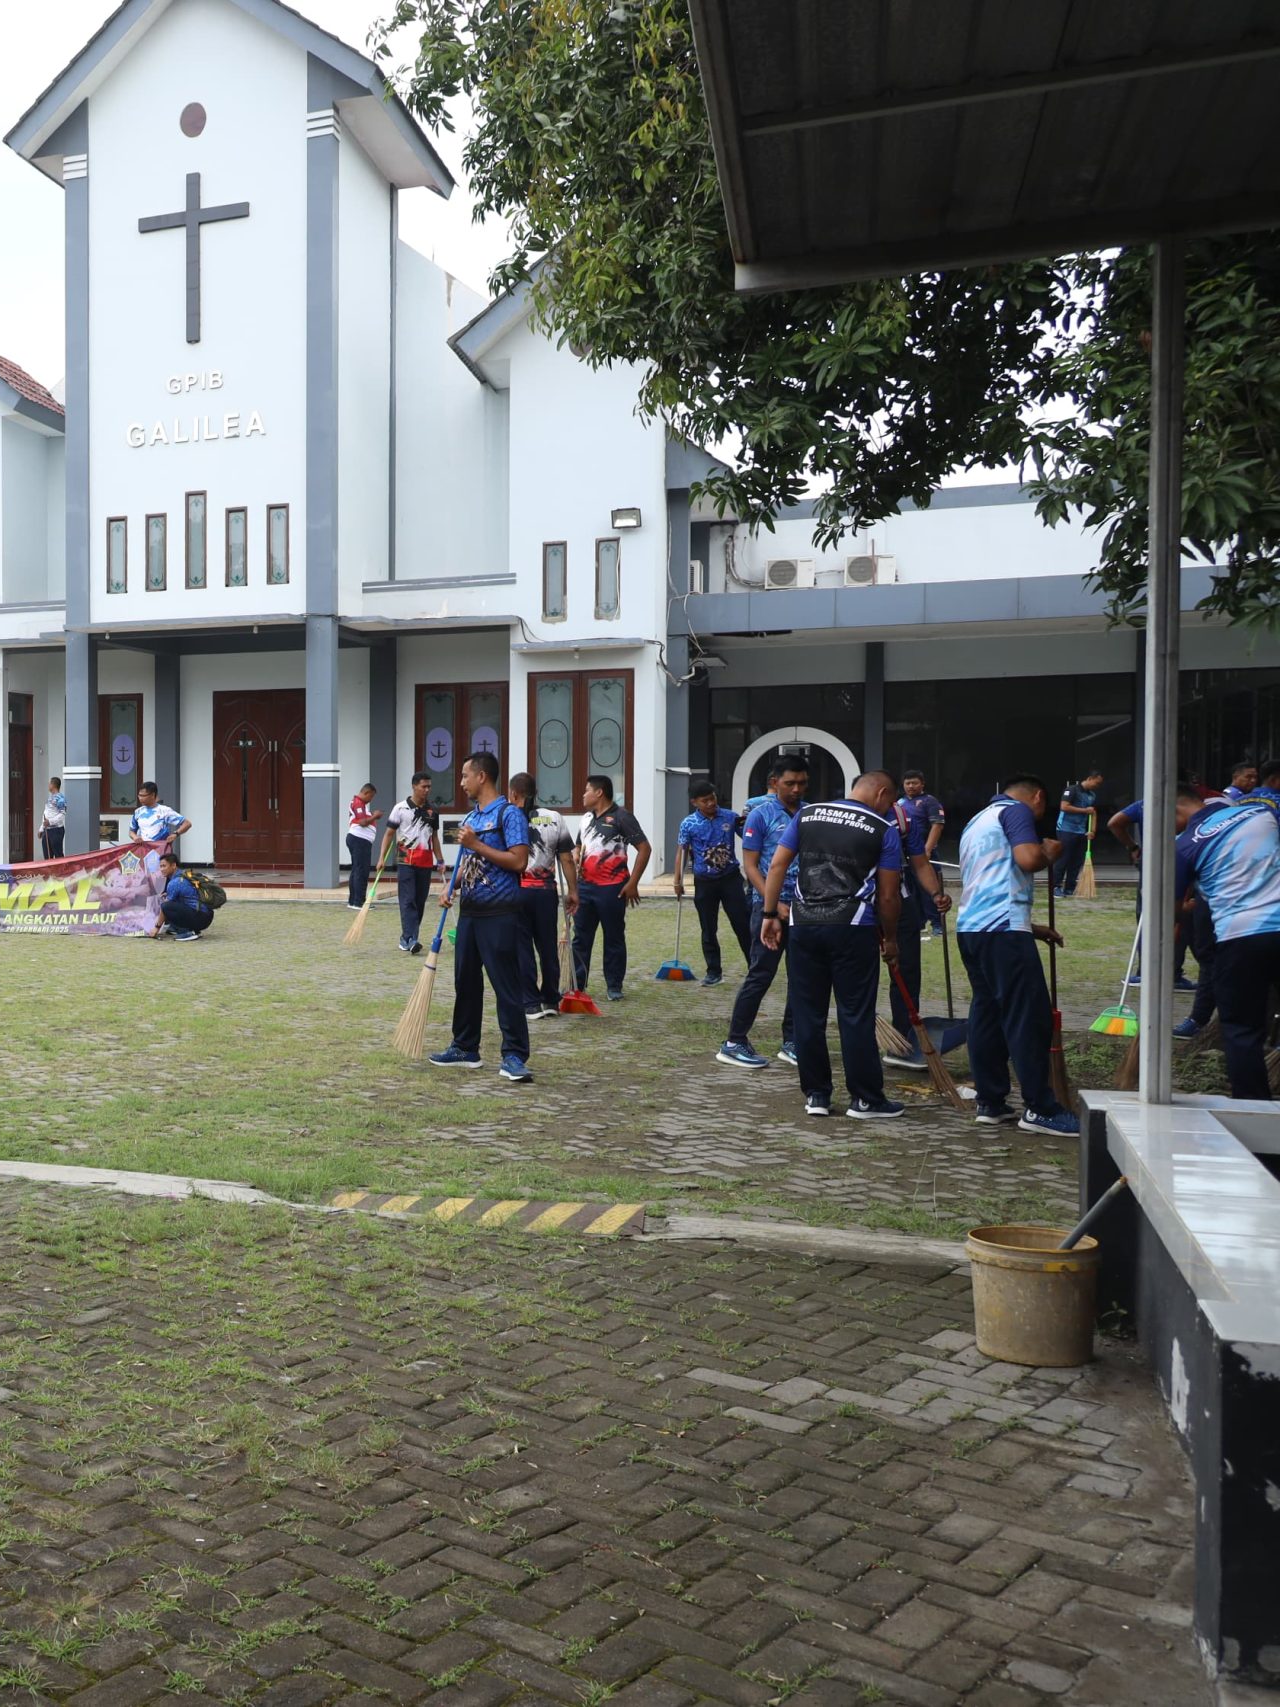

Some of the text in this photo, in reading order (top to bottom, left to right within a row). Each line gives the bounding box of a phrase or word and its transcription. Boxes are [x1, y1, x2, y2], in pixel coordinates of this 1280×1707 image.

[167, 369, 224, 395] GPIB
[125, 409, 266, 448] GALILEA
[814, 808, 866, 823] PASMAR 2
[844, 820, 876, 834] PROVOS
[3, 913, 79, 925] ANGKATAN
[82, 912, 117, 925] LAUT
